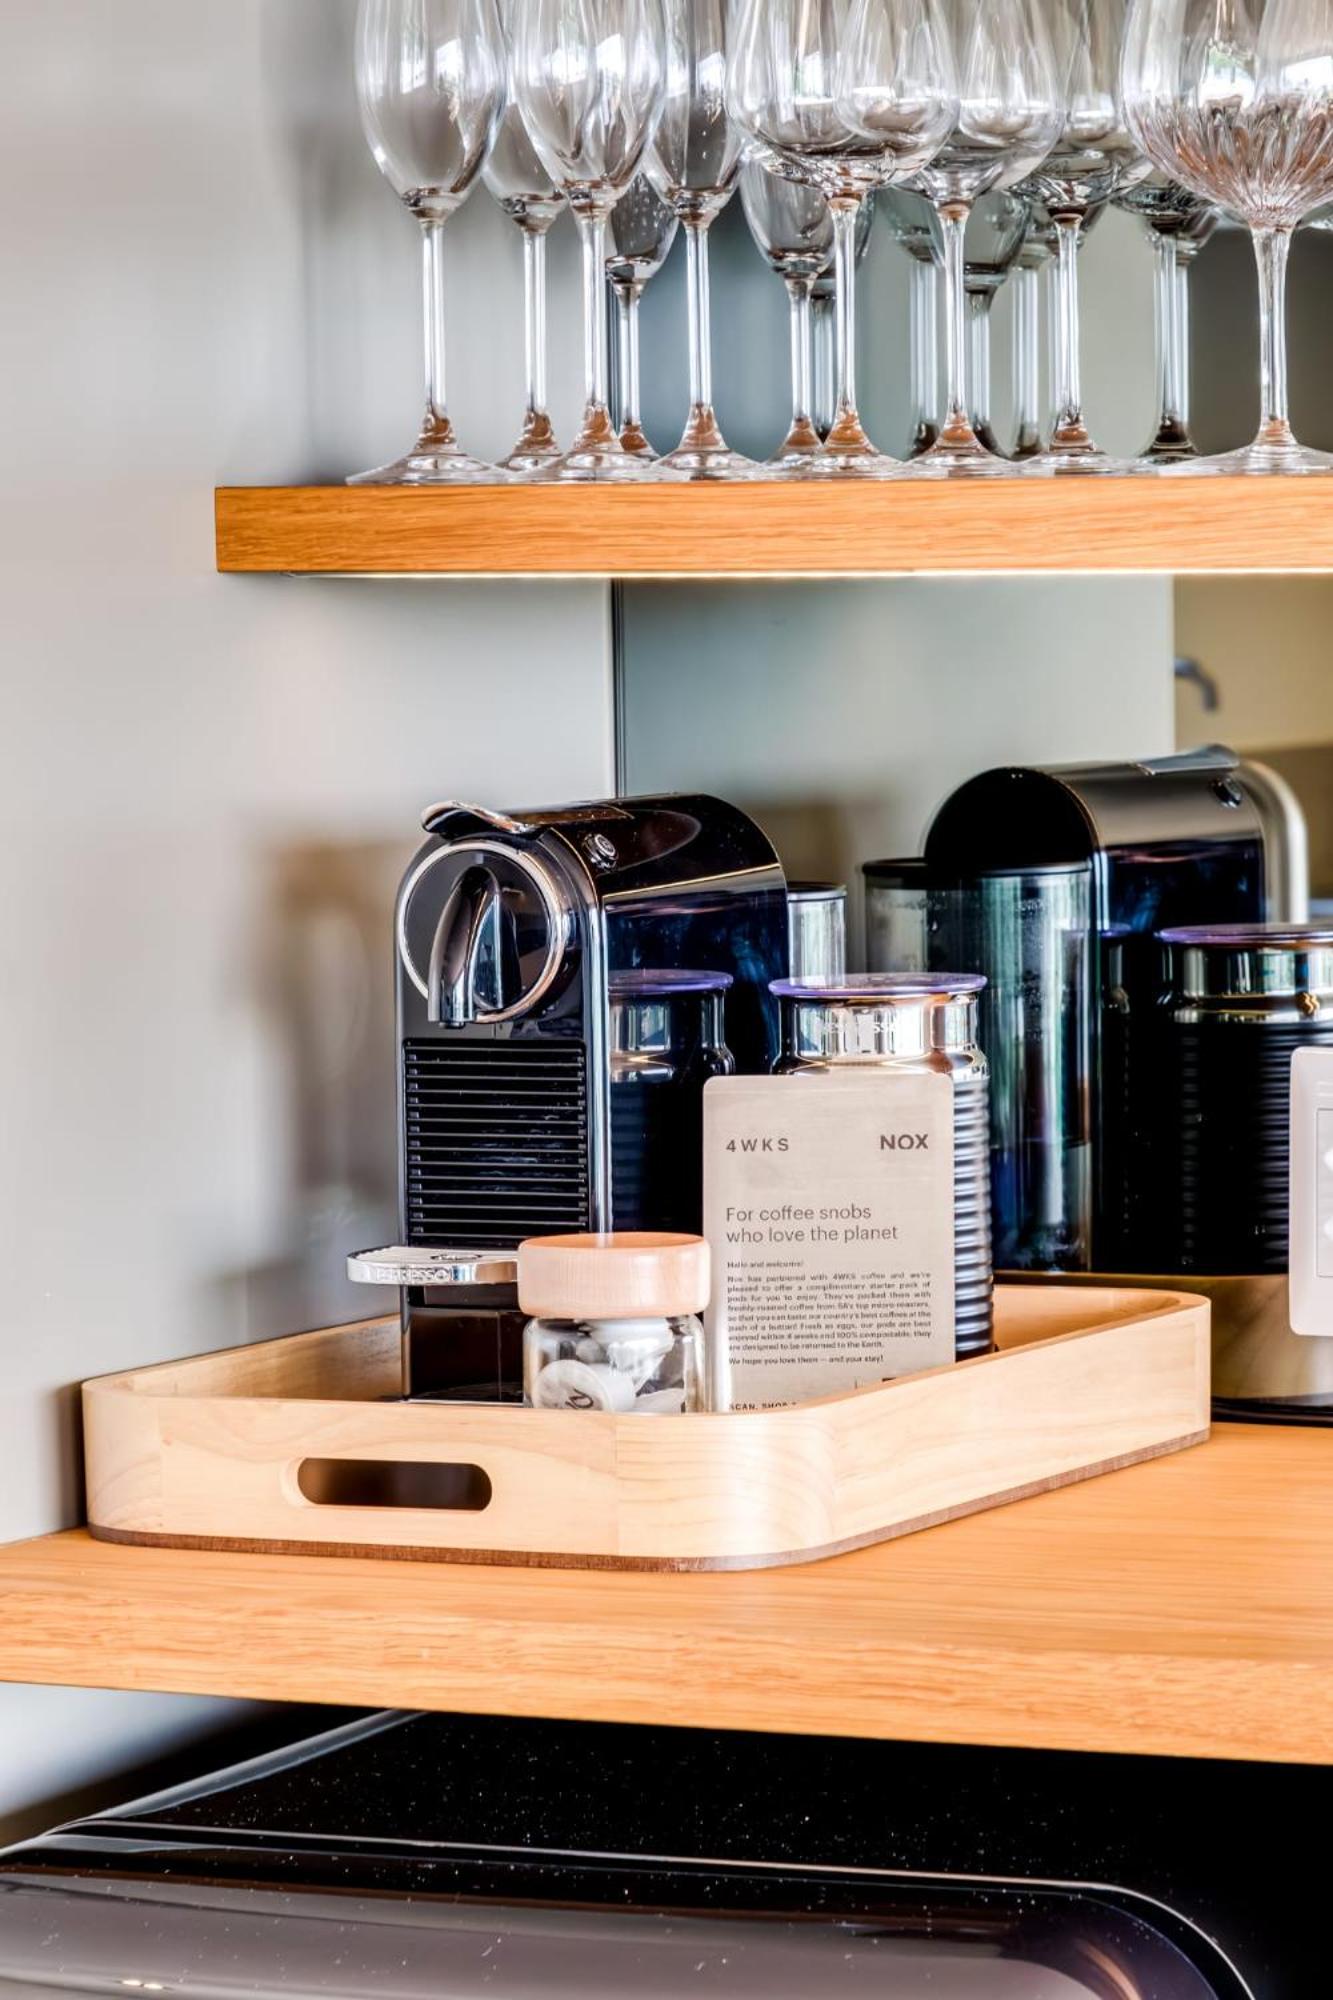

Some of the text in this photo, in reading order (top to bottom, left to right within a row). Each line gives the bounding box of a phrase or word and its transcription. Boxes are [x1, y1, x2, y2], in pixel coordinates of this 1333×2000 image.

[726, 1138, 789, 1152] 4WKS
[880, 1134, 928, 1150] NOX
[727, 1203, 871, 1222] For coffee snobs
[726, 1225, 897, 1243] who love the planet
[766, 1274, 805, 1283] partnered
[728, 1333, 759, 1342] enjoyed
[914, 1329, 931, 1338] they
[742, 1342, 779, 1352] designed
[801, 1341, 836, 1349] returned
[742, 1357, 762, 1366] hope
[864, 1354, 884, 1363] stay!
